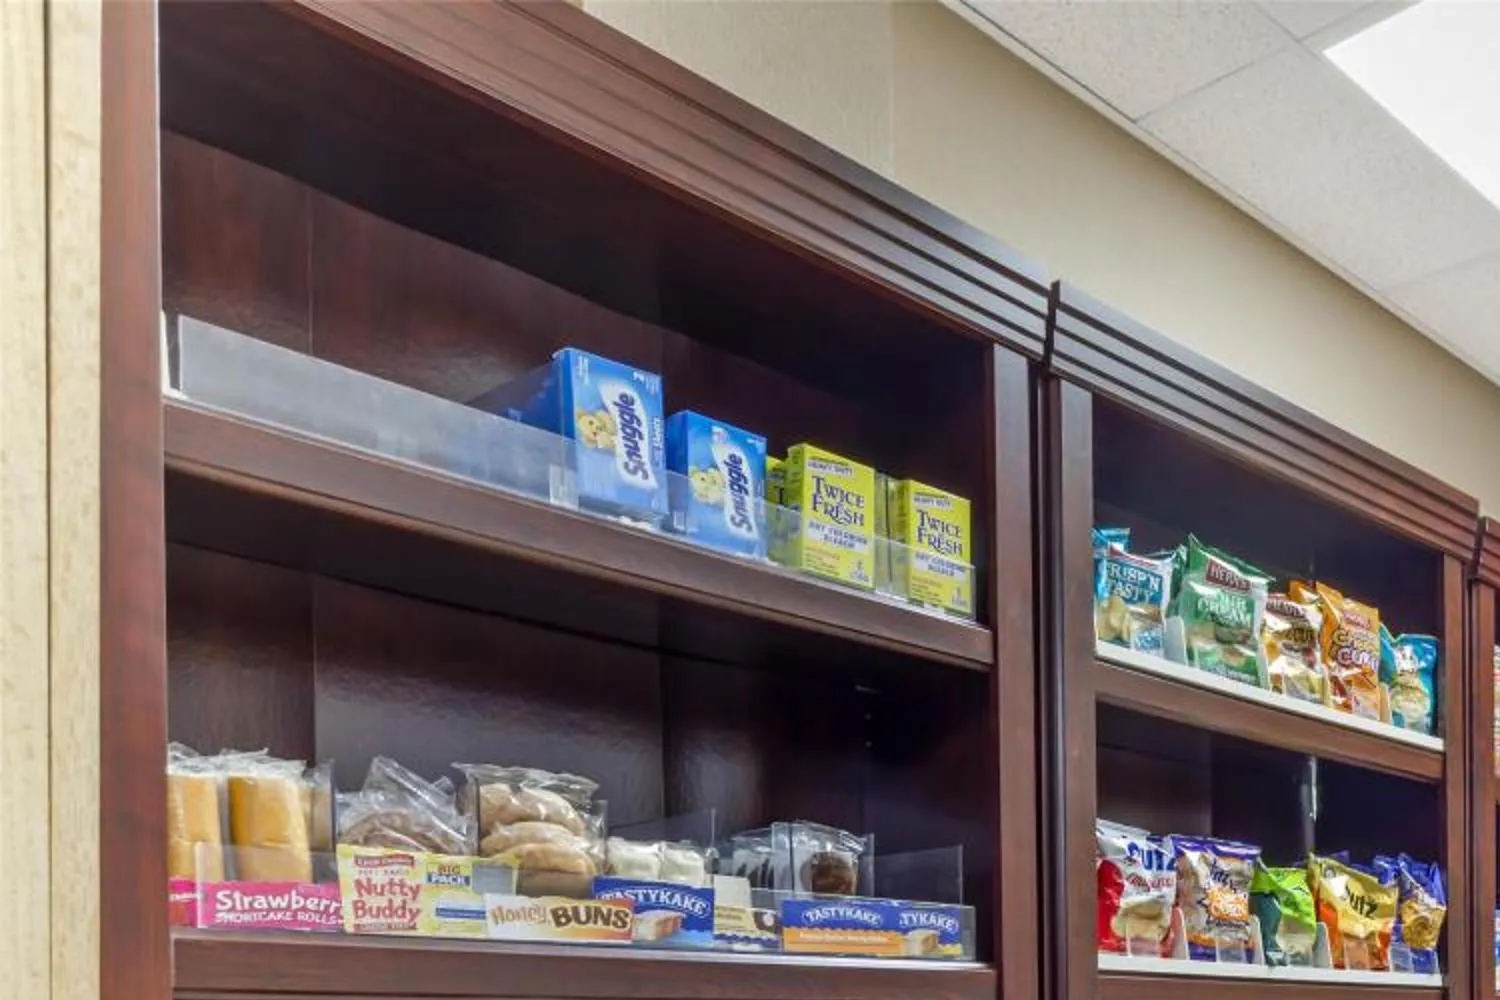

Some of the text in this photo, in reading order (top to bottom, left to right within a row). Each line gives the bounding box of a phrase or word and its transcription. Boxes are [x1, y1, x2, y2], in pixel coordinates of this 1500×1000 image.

[613, 391, 649, 481] Snuggle
[723, 452, 753, 532] Snuggle
[811, 474, 865, 509] TWICE
[811, 493, 865, 527] FRESH
[917, 509, 962, 539] TWICE
[916, 526, 963, 556] FRESH
[215, 889, 341, 914] Strawberr
[354, 878, 423, 901] Nutty
[351, 898, 422, 924] Buddy
[549, 904, 632, 930] BUNS
[805, 906, 882, 925] TASTYKAKE
